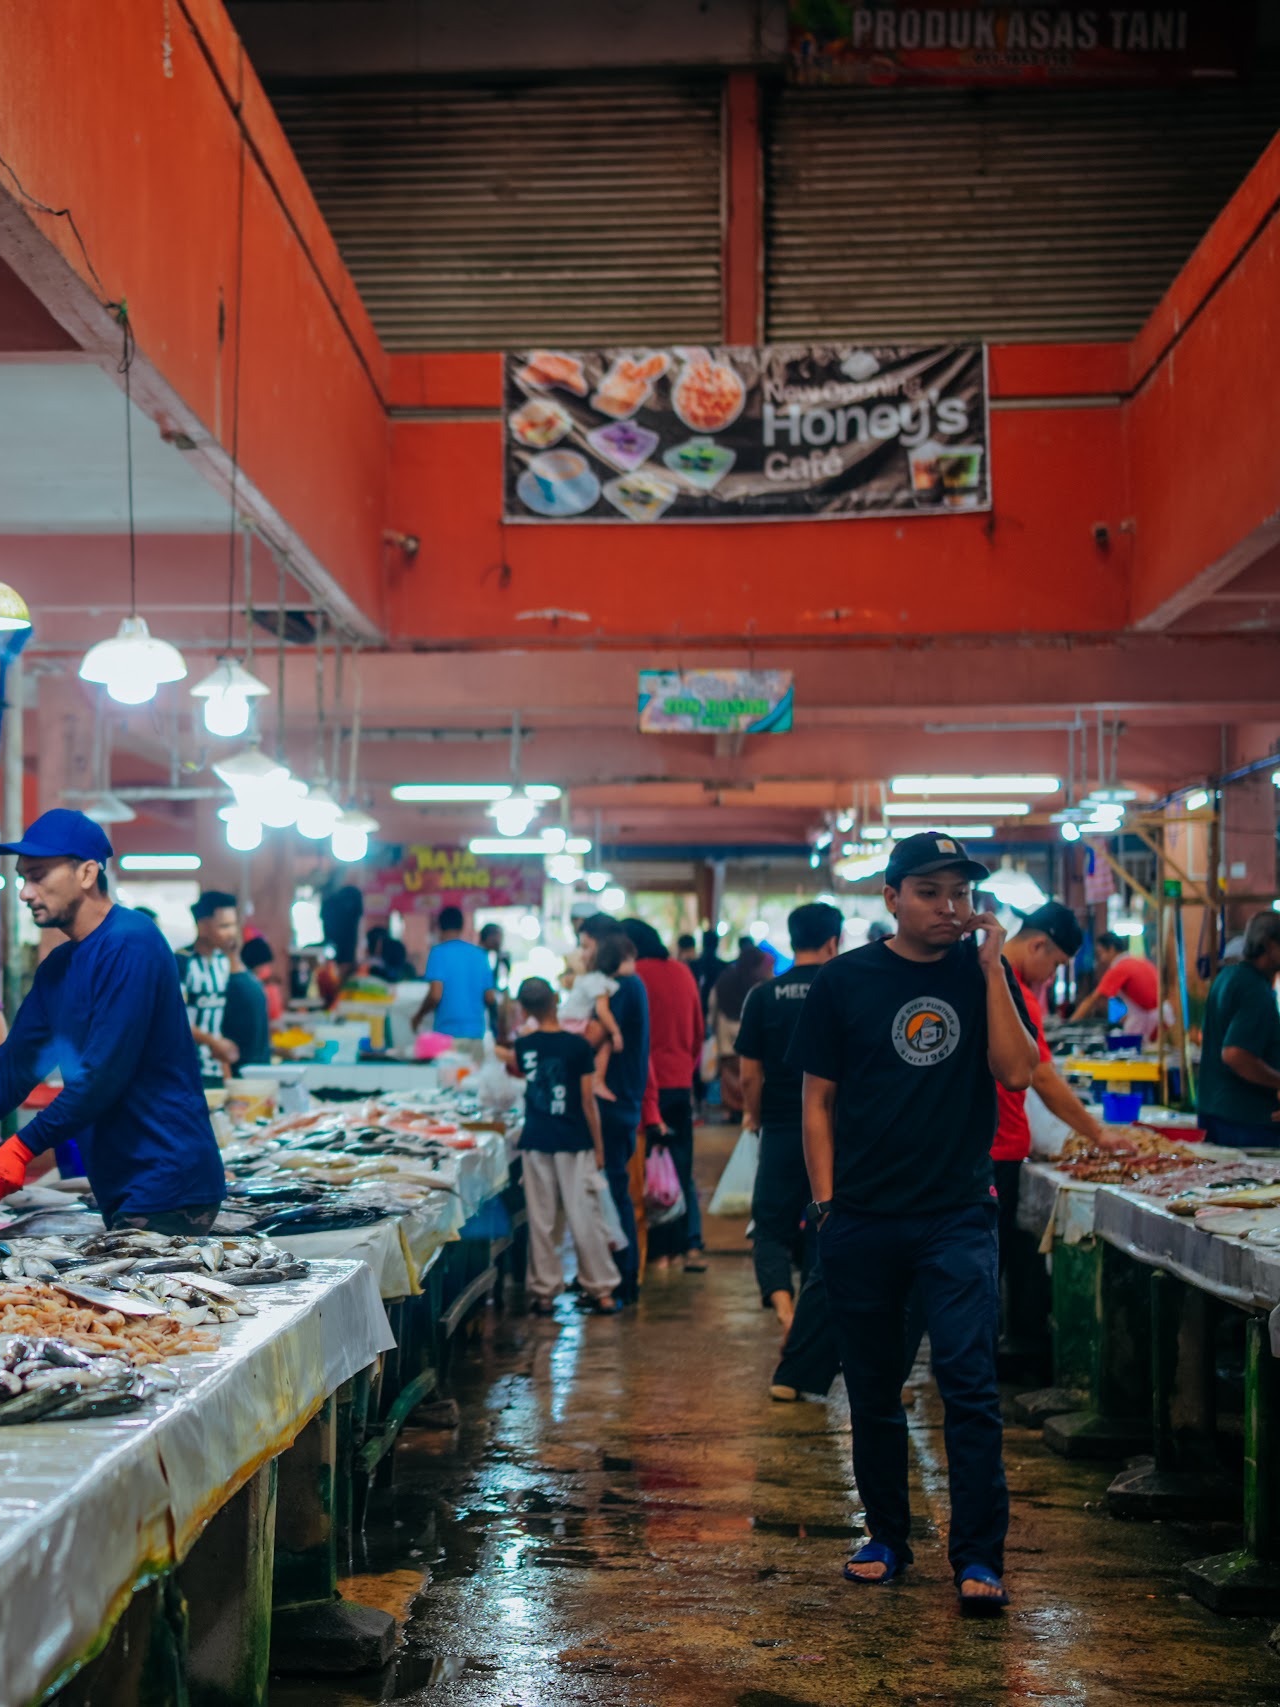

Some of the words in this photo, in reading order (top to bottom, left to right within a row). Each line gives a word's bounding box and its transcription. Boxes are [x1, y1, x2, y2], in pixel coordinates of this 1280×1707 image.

[852, 8, 996, 50] PRODUK
[1005, 8, 1098, 50] ASAS
[1110, 9, 1187, 50] TANI
[763, 387, 969, 448] Honey's
[764, 447, 844, 482] Café
[897, 1014, 907, 1031] ONE
[906, 1002, 924, 1016] STEP
[926, 1003, 955, 1025] FURTHER
[900, 1050, 922, 1063] SINCE
[925, 1045, 950, 1062] 1967
